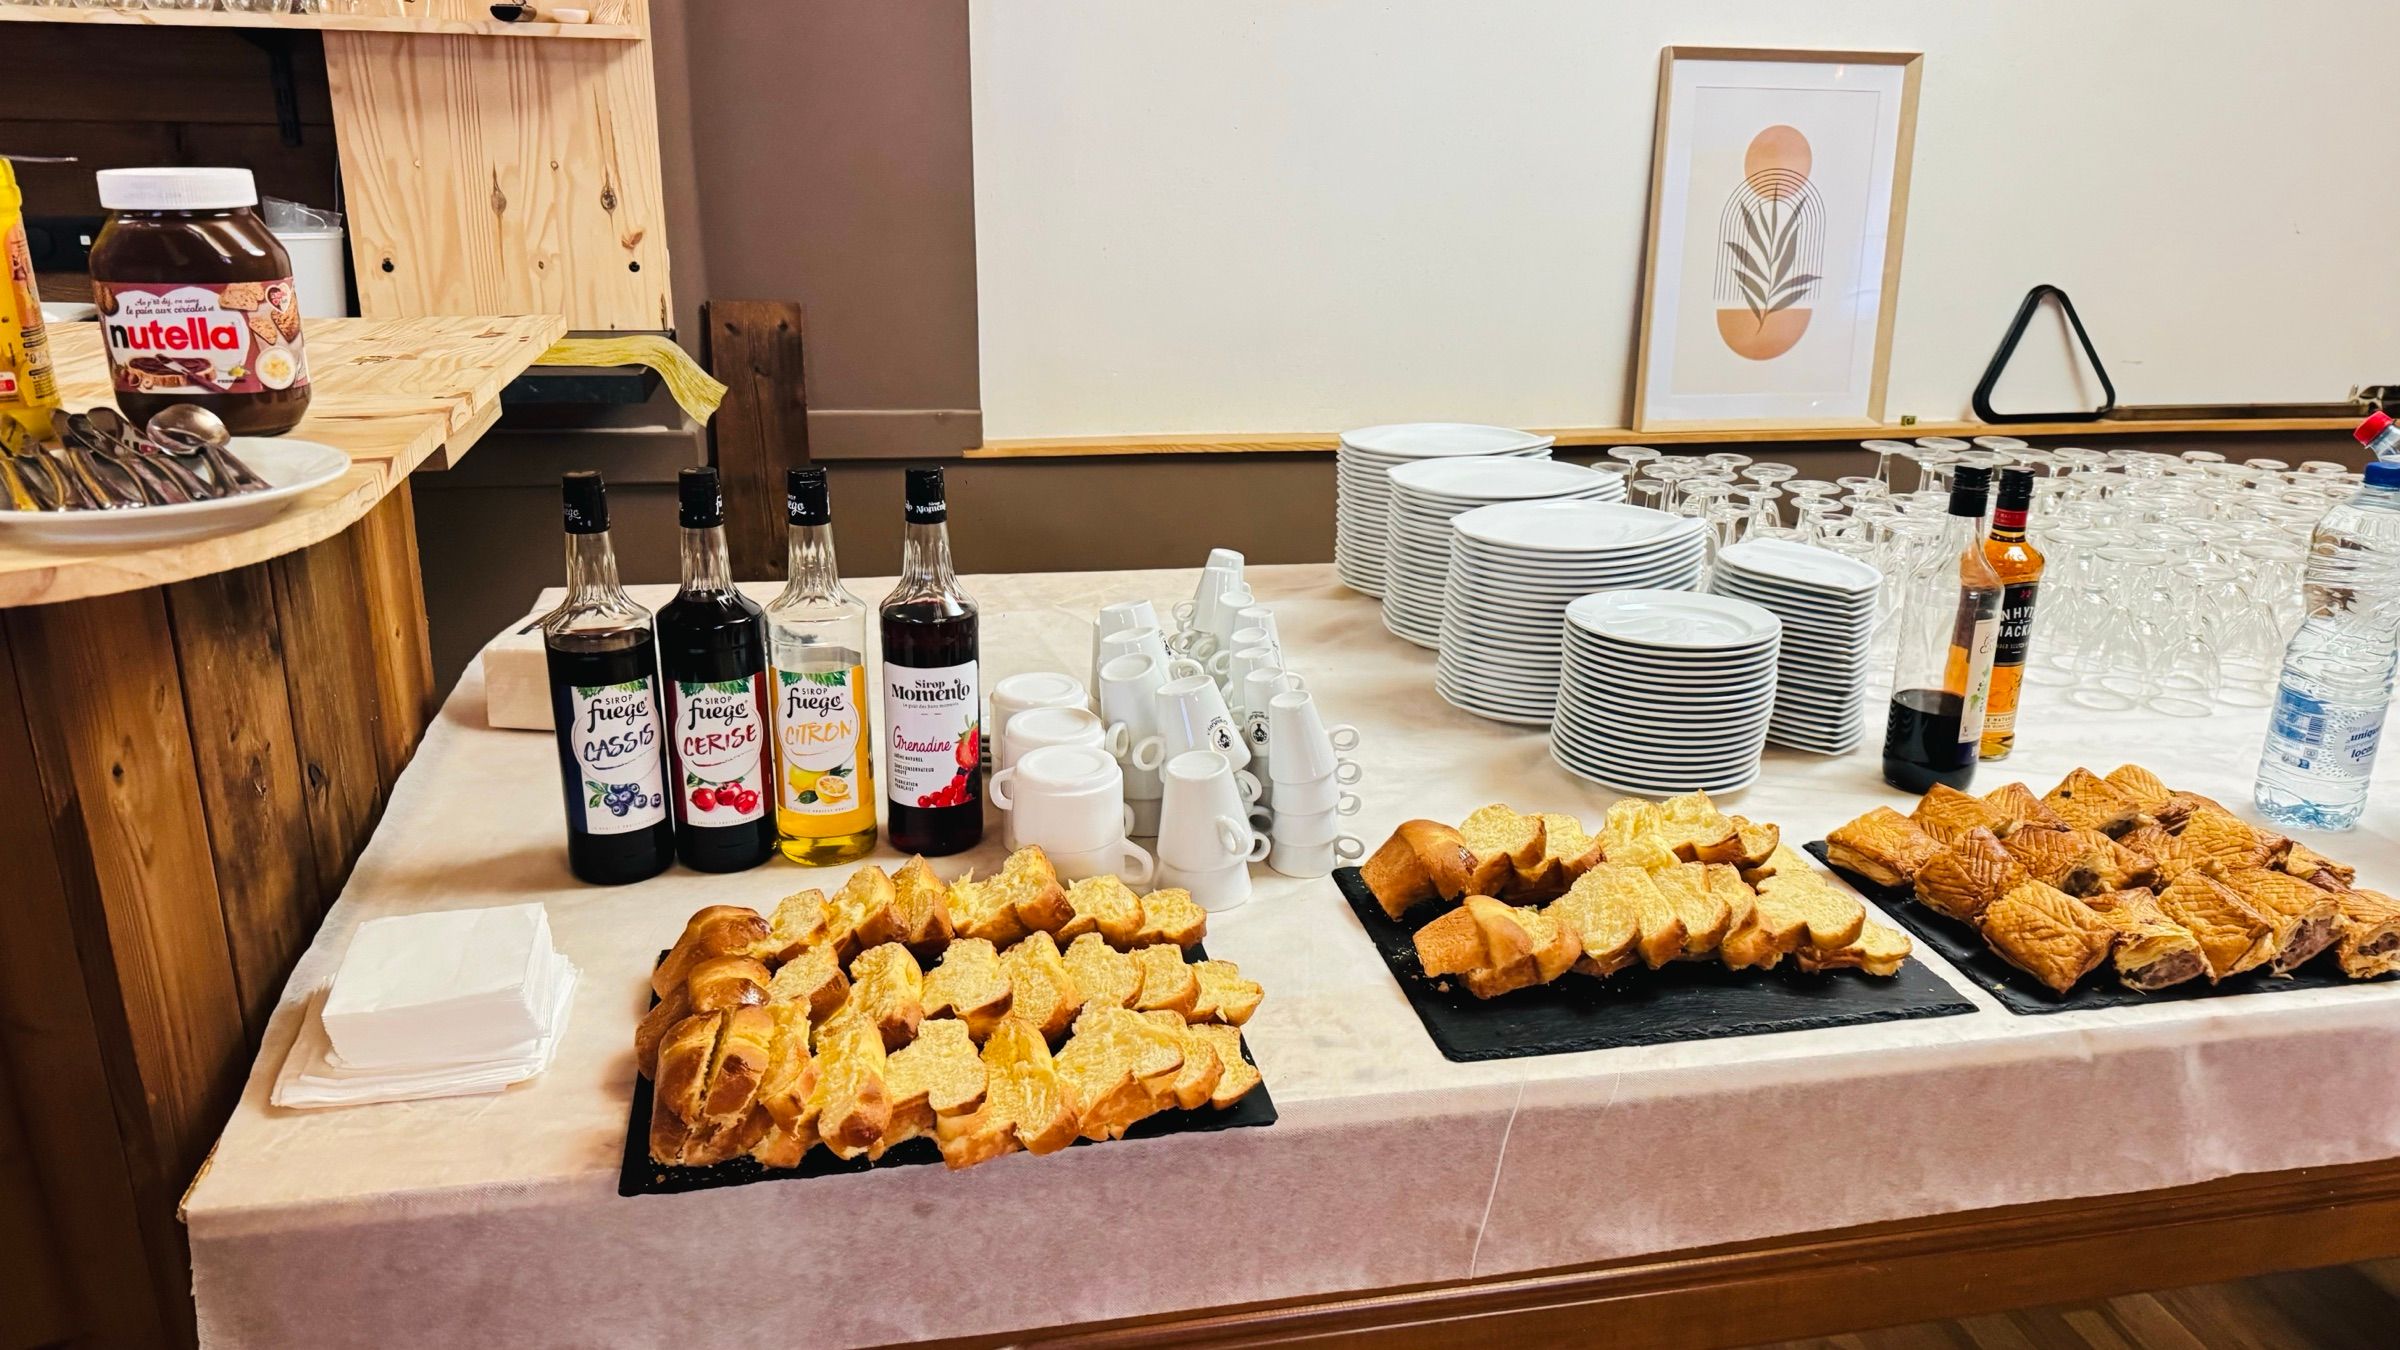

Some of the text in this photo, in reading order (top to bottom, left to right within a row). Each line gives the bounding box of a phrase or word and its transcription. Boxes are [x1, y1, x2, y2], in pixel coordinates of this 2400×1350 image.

[135, 306, 153, 318] pain
[174, 302, 207, 314] céréales
[109, 317, 240, 350] nutella
[801, 687, 828, 695] SIROP
[891, 678, 970, 701] Momento
[915, 679, 945, 690] Sirop
[605, 694, 633, 706] SIROP
[705, 696, 732, 705] SIROP
[786, 687, 844, 719] fuego
[586, 698, 649, 734] fuego
[687, 697, 748, 731] fuego
[584, 723, 655, 763] CASSIS
[683, 723, 757, 757] CERISE
[785, 720, 852, 745] CITRON
[893, 725, 951, 753] Grenadine
